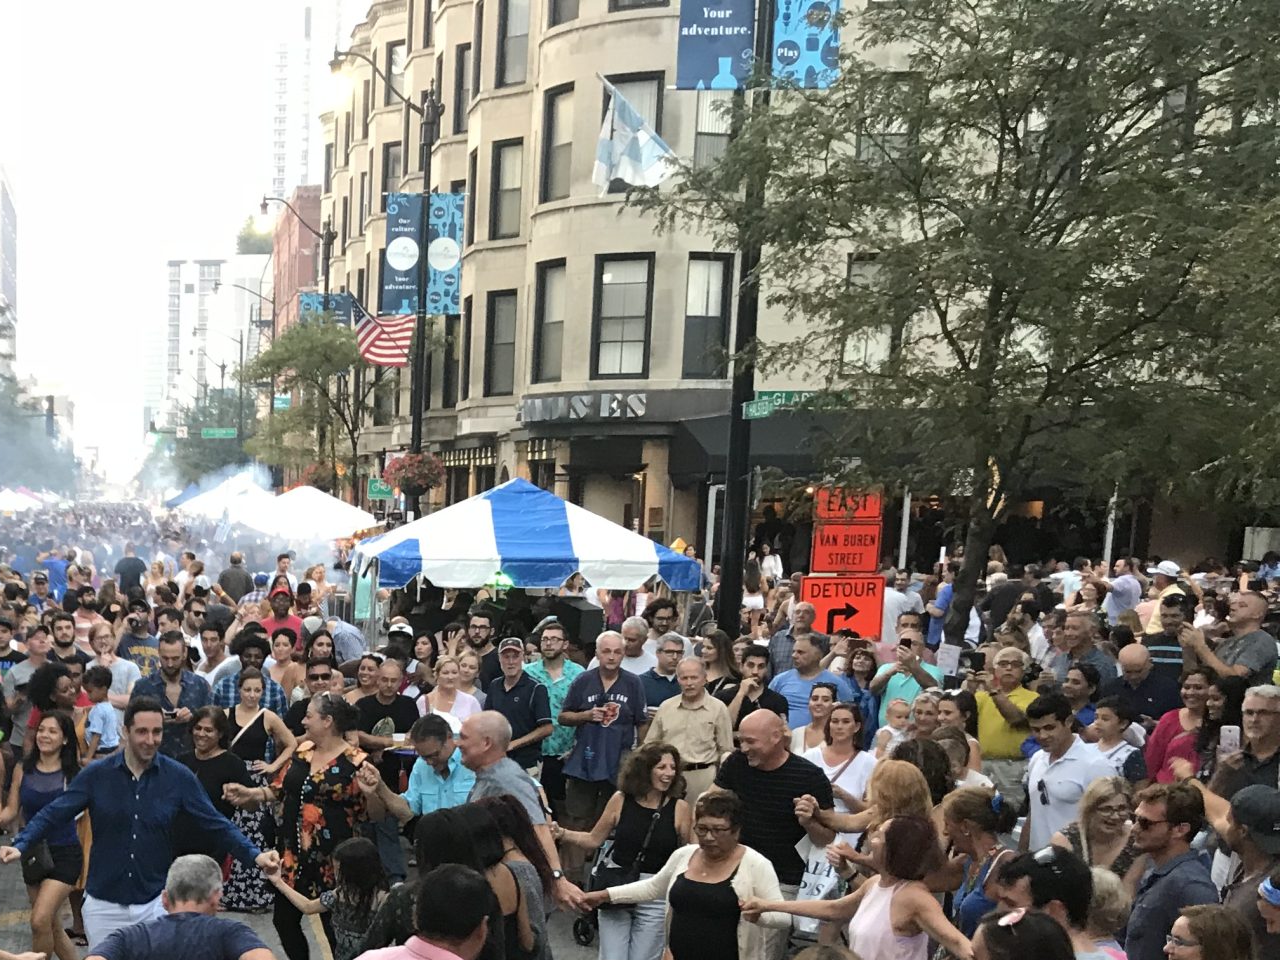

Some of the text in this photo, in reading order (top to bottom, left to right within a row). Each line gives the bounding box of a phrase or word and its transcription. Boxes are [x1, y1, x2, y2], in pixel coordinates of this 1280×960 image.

[703, 7, 733, 19] Your
[681, 24, 752, 36] adventure.
[777, 47, 799, 59] Play
[828, 493, 868, 512] EAST
[820, 534, 876, 547] VAN BUREN
[828, 552, 864, 566] STREET
[811, 582, 877, 598] DETOUR
